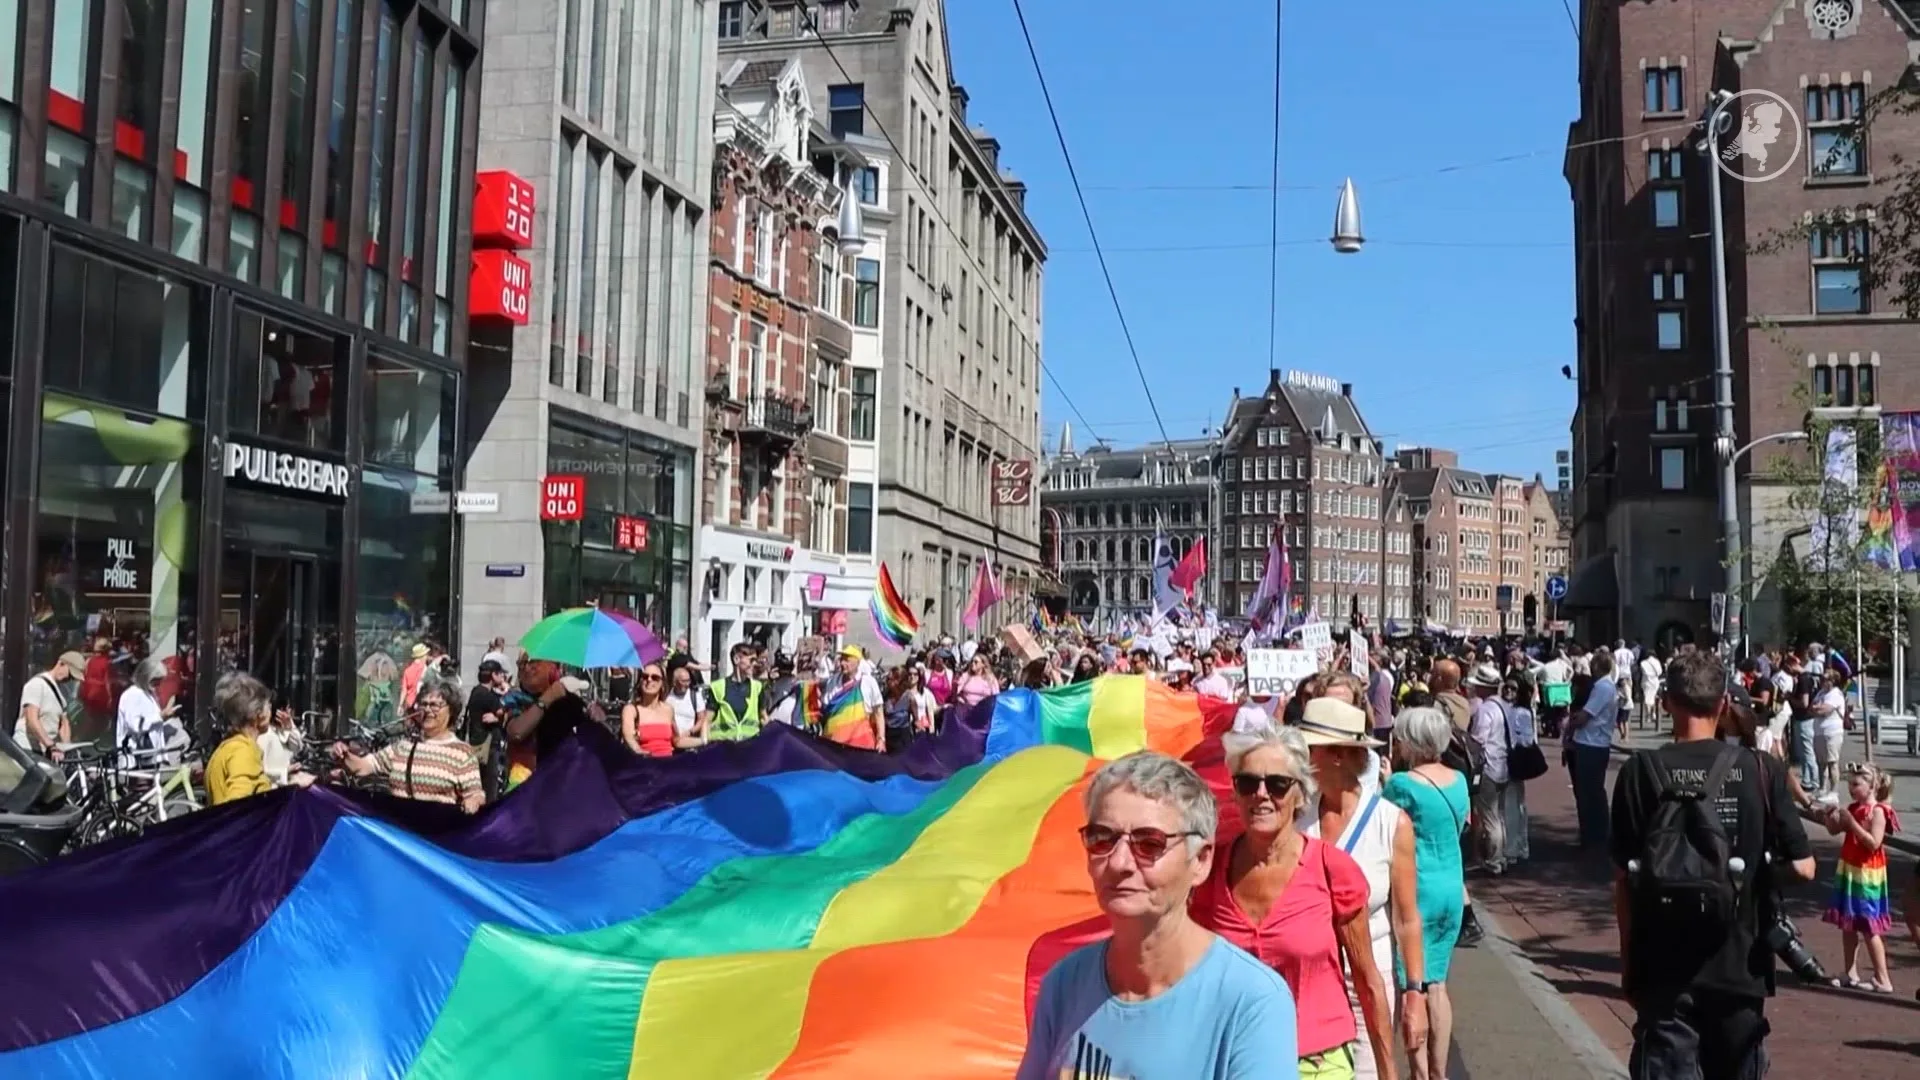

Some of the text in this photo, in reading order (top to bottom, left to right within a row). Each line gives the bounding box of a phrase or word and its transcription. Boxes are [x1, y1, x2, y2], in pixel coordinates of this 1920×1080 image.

[503, 259, 526, 289] UNI
[502, 287, 527, 315] QLO
[1288, 370, 1338, 392] ABN AMRO
[223, 443, 348, 498] PULL&BEAR
[547, 482, 575, 497] UNI
[546, 499, 578, 517] QLO
[107, 537, 135, 559] PULL
[103, 568, 137, 588] PRIDE
[1251, 651, 1310, 663] BREAK
[1264, 663, 1297, 674] THE
[1250, 677, 1299, 694] TABO
